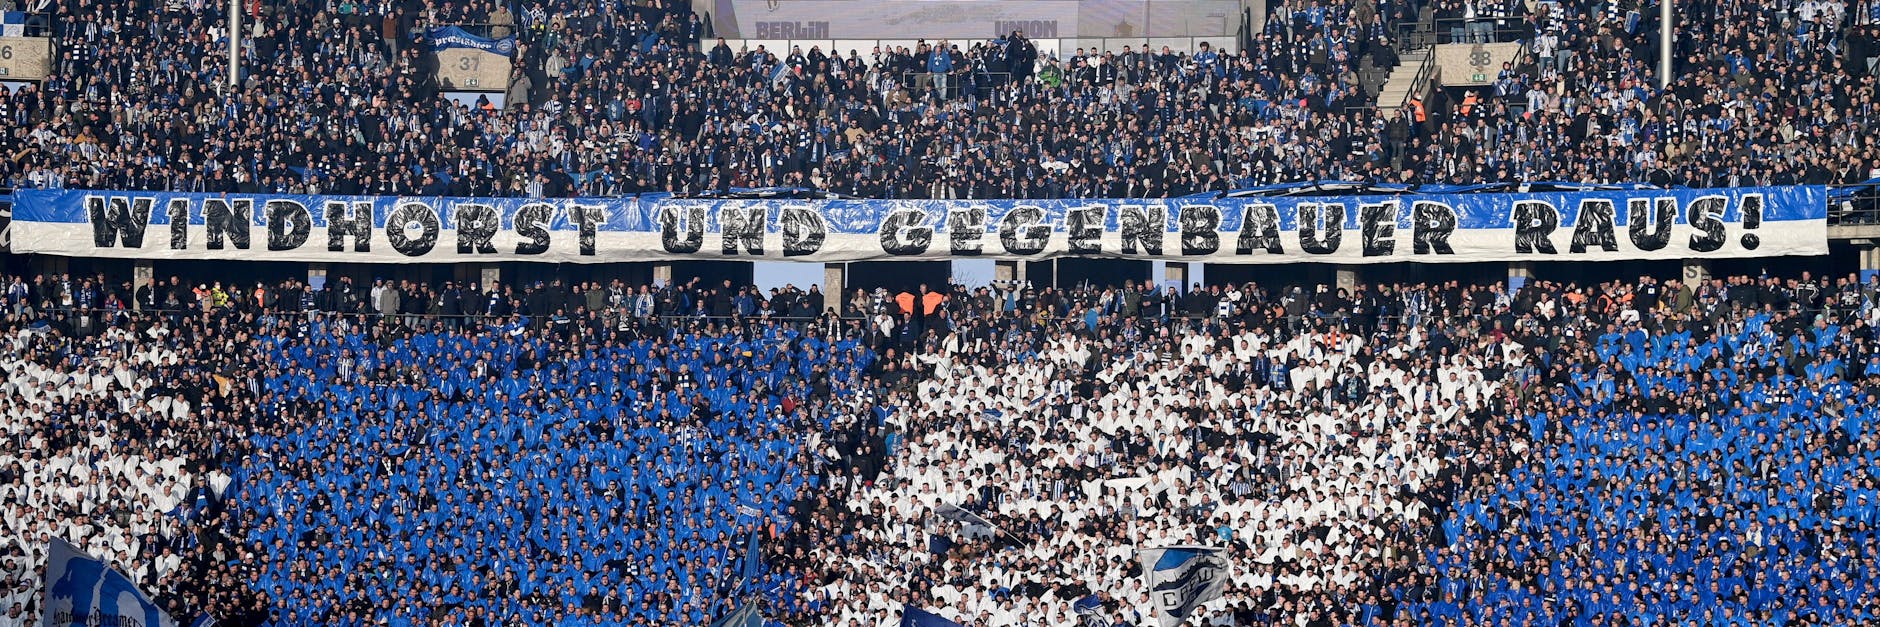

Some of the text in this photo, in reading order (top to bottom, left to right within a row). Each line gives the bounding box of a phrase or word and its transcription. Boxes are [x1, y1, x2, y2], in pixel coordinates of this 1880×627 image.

[994, 20, 1058, 38] UNION
[460, 56, 479, 71] 37
[1470, 51, 1491, 66] 38
[87, 195, 1763, 257] WINDHORST UND GEGENBAUER RAUS!
